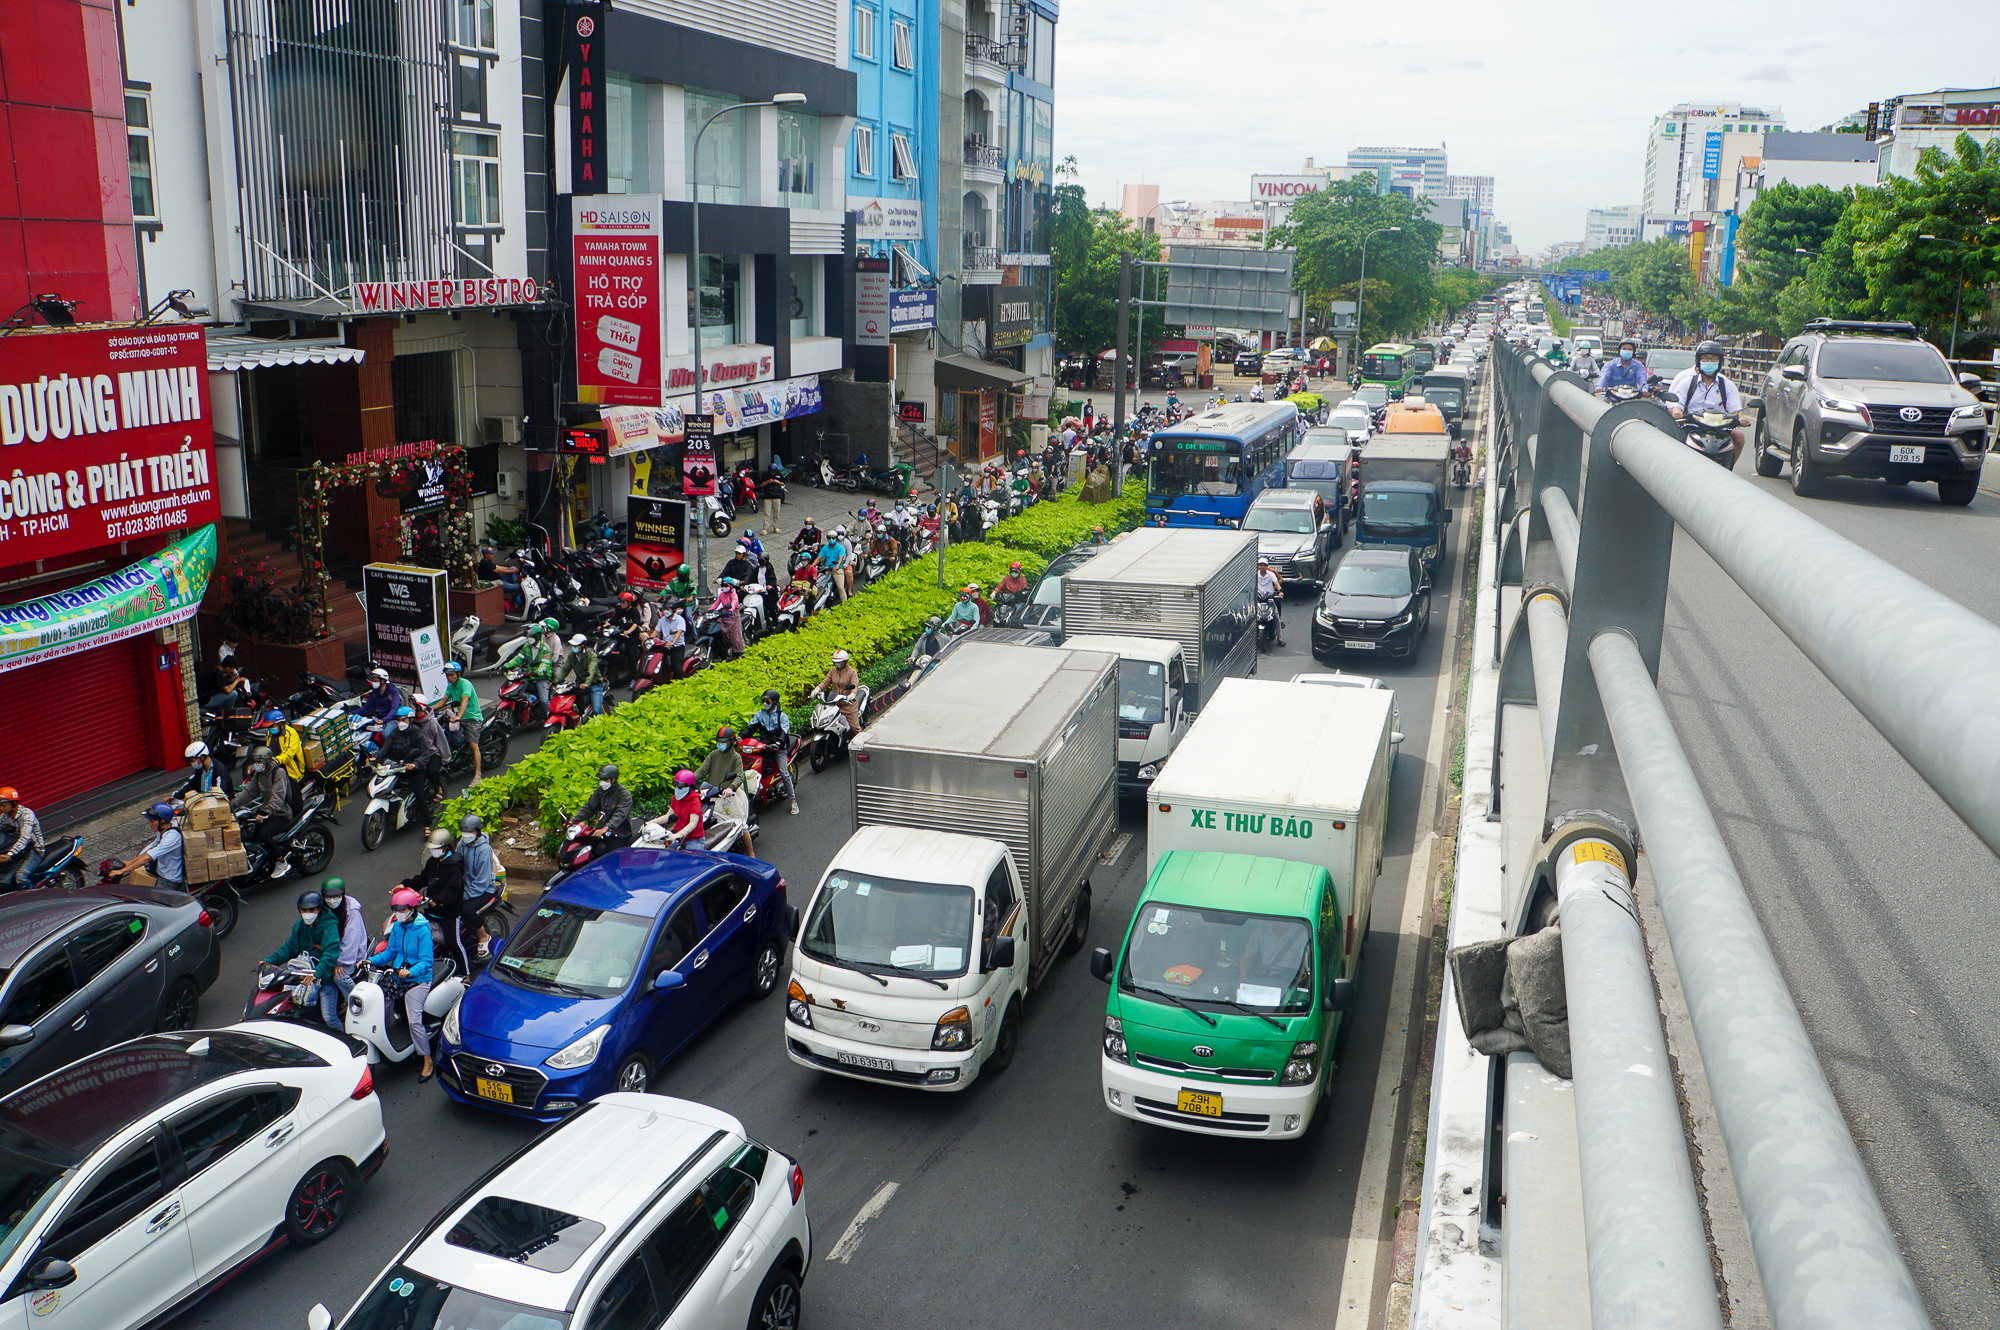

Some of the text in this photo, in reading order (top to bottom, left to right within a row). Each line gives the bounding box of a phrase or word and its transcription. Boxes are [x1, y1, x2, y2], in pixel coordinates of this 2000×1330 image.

[580, 43, 593, 181] YAMAHA
[1884, 99, 1892, 130] HOTEL
[1707, 134, 1721, 142] yola
[581, 211, 650, 223] HD SAISON
[585, 242, 647, 251] YAMAHA TOWM
[580, 256, 653, 267] MINH QUANG 5
[589, 273, 643, 292] HỖ TRỢ
[358, 278, 537, 311] WINNER BISTRO
[586, 291, 647, 309] TRẢ GÓP
[1011, 302, 1030, 321] HOTEL
[167, 333, 178, 344] TẠO
[179, 332, 199, 341] TP.HCM
[610, 329, 636, 345] THẤP
[612, 358, 633, 369] CMND
[612, 368, 630, 380] GPLX
[670, 356, 771, 388] Minh Quang 5
[0, 366, 201, 446] DƯƠNG MINH
[575, 437, 599, 448] BIDA
[687, 440, 710, 450] 20%
[1206, 456, 1217, 465] 104
[0, 435, 209, 521] CÔNG & PHÁT TRIỂN
[417, 485, 444, 498] WINNER
[101, 489, 211, 521] www.duongminh.edu.vn
[20, 513, 70, 538] TP.HCM
[144, 512, 163, 532] 3811
[164, 509, 188, 529] 0485
[635, 521, 675, 535] WINNER
[634, 533, 660, 542] BILLIARDS
[100, 564, 154, 597] Mới
[41, 628, 62, 645] 01/01
[68, 614, 109, 637] 15/01/2023
[378, 631, 398, 642] WORLD
[61, 645, 75, 654] cho
[77, 641, 90, 651] học
[93, 636, 109, 645] viên
[1191, 809, 1313, 839] XE THƯ BÁO
[169, 944, 181, 956] Grab
[1196, 1048, 1211, 1056] KIA
[486, 1082, 502, 1091] 51G
[482, 1088, 508, 1101] 118.07
[1191, 1094, 1210, 1104] 29H
[1182, 1102, 1217, 1115] 708.13
